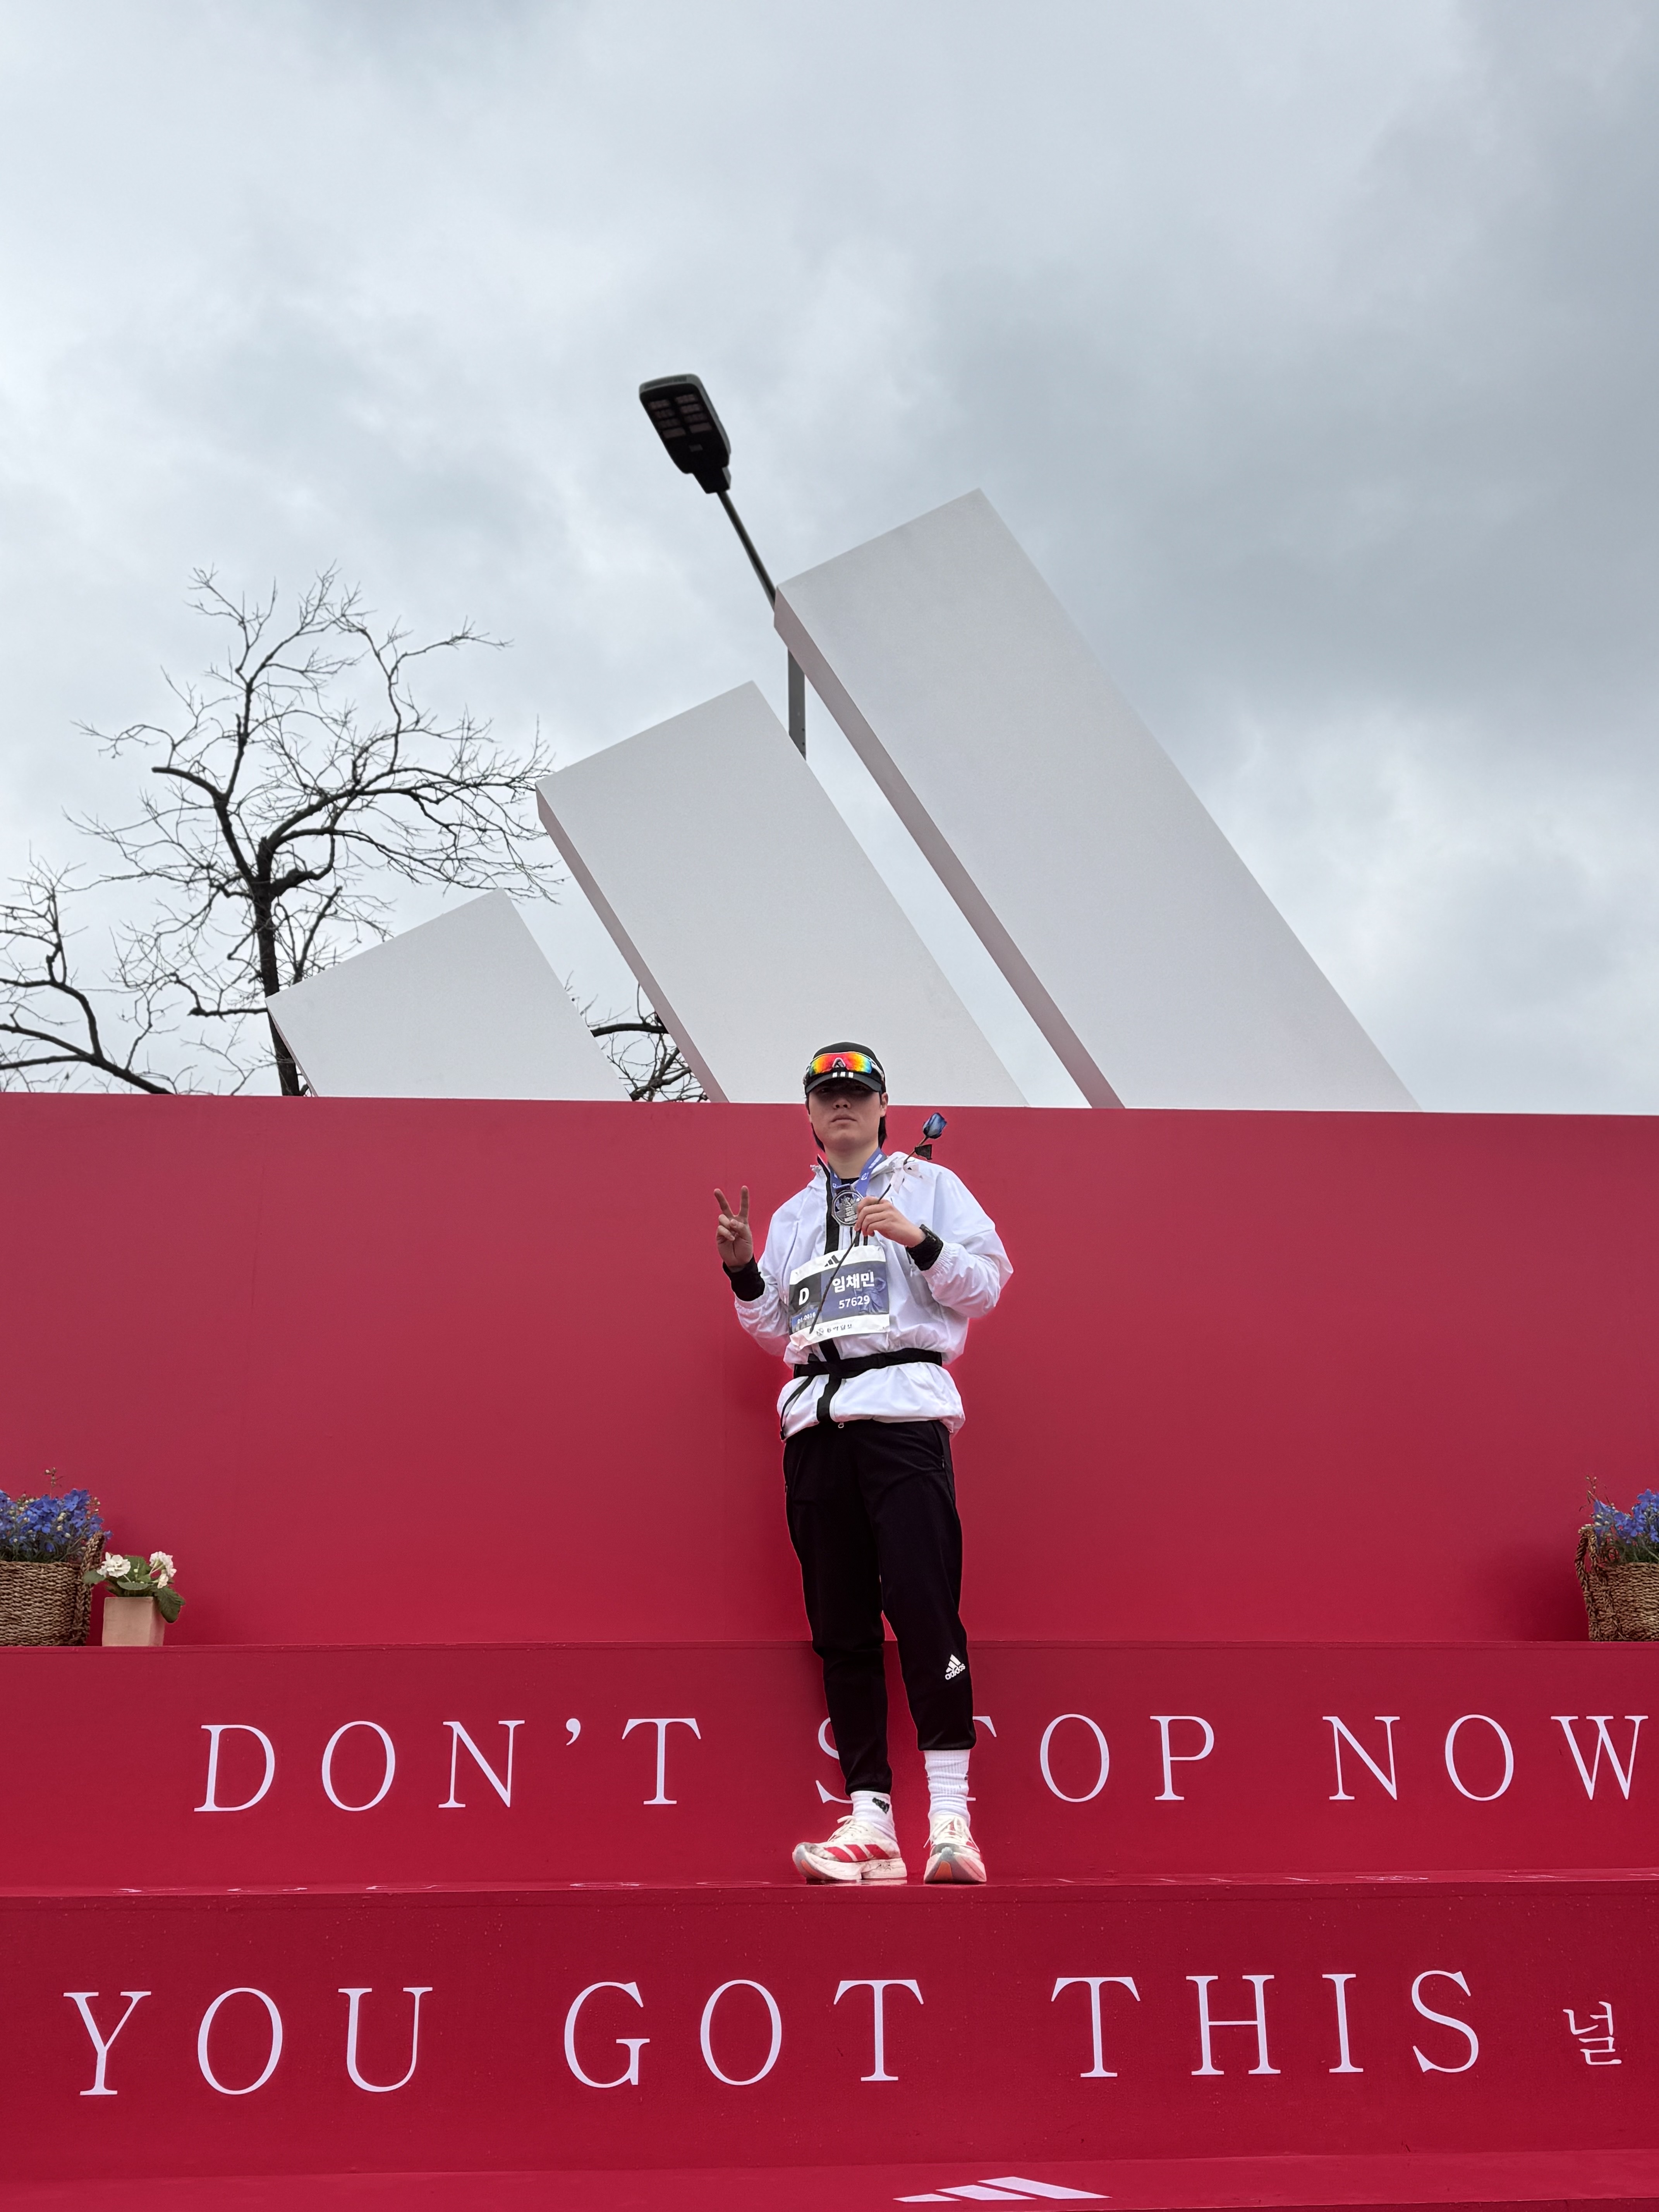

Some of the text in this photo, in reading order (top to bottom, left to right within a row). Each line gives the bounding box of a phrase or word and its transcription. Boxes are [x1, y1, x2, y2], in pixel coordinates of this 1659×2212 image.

[799, 1287, 810, 1305] D
[832, 1271, 875, 1293] 임채민
[838, 1295, 871, 1309] 57629
[194, 1718, 701, 1812] DON’T
[1322, 1714, 1649, 1801] NOW
[63, 1970, 1479, 2095] YOU GOT THIS
[1563, 2001, 1622, 2065] 널
